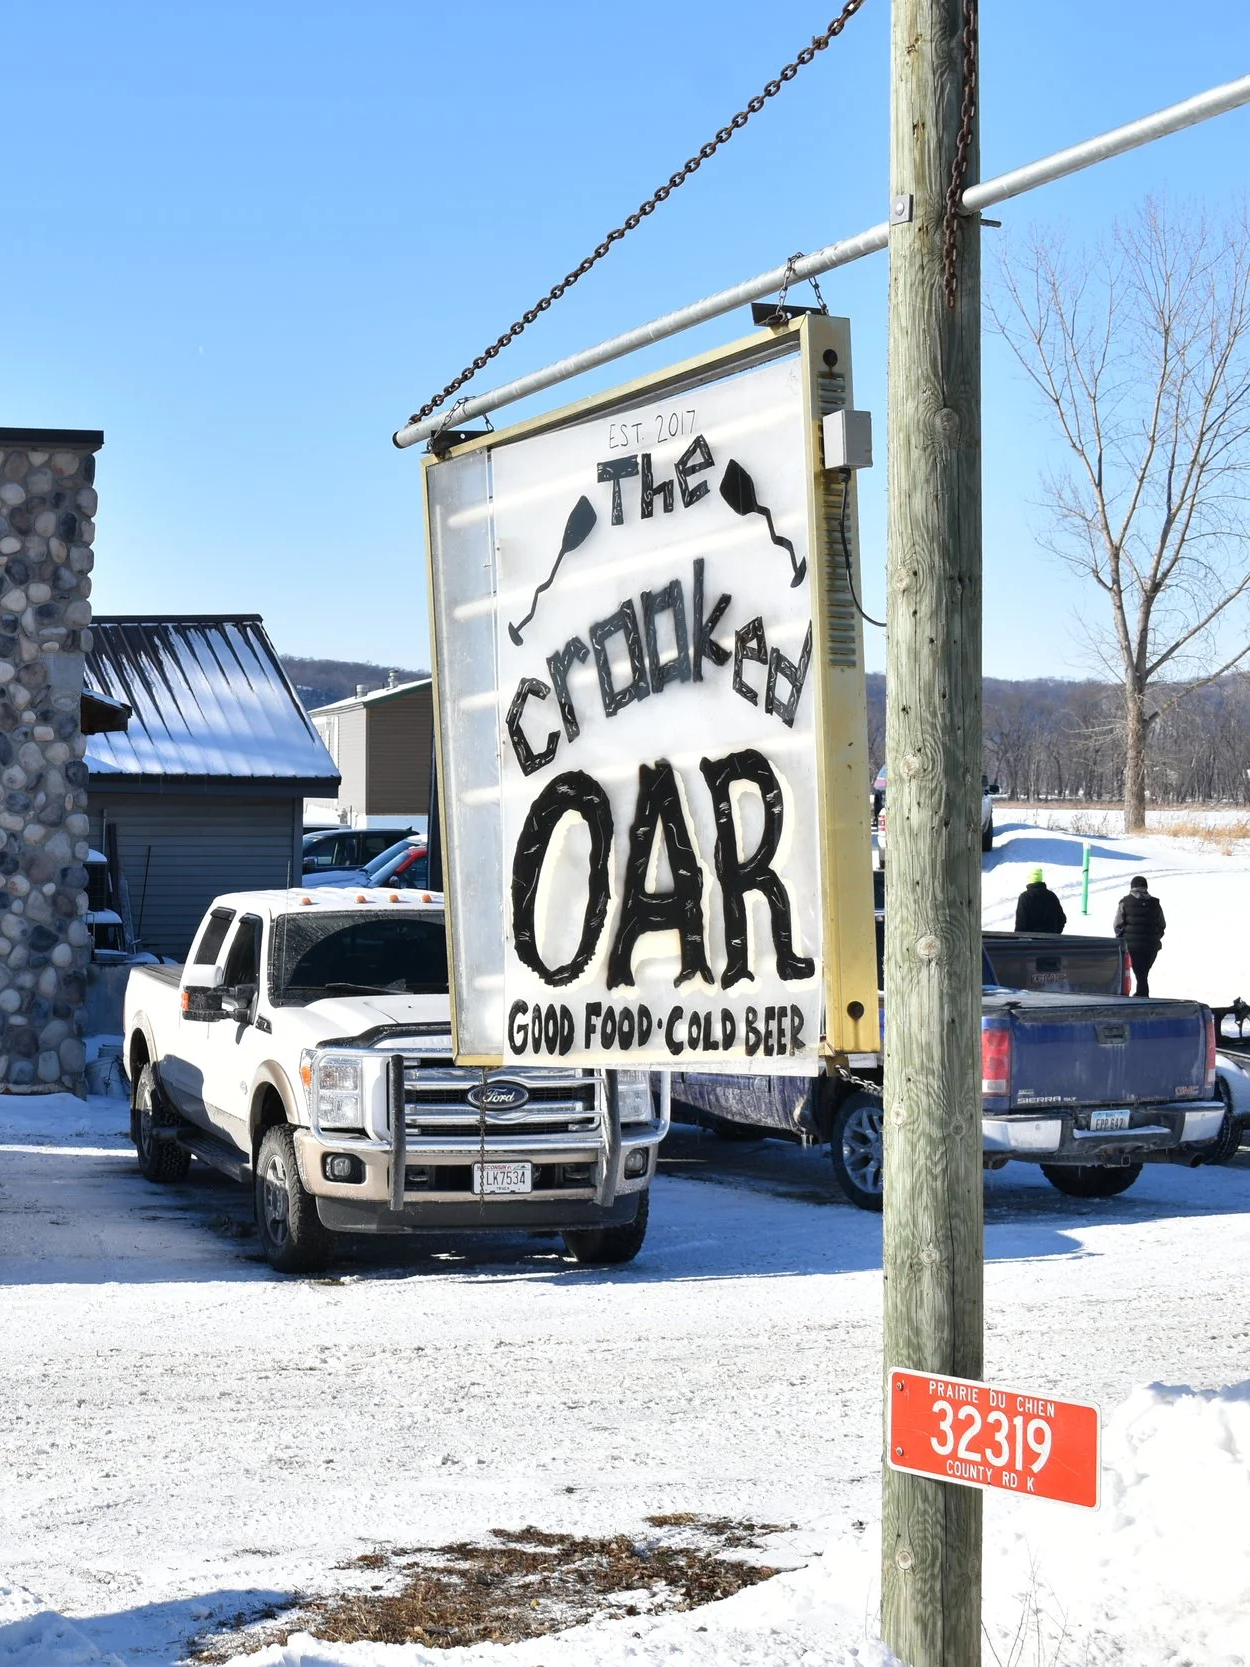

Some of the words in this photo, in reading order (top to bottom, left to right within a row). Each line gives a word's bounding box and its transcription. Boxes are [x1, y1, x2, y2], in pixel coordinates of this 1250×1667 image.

[609, 422, 645, 449] EST.
[656, 409, 697, 444] 2017
[596, 434, 715, 526] The
[510, 748, 816, 991] OAR
[507, 997, 575, 1057] GOOD
[745, 1003, 808, 1057] BEER
[482, 1088, 515, 1103] Ford
[1017, 1095, 1062, 1104] SIERRA
[486, 1170, 526, 1186] LK7534
[929, 1380, 979, 1404] PRAIRIE
[989, 1388, 1006, 1409] DU
[1016, 1396, 1055, 1418] CHIEN
[930, 1399, 1052, 1474] 32319
[946, 1459, 993, 1482] COUNTY
[1002, 1471, 1018, 1488] RD
[1027, 1477, 1035, 1492] K
